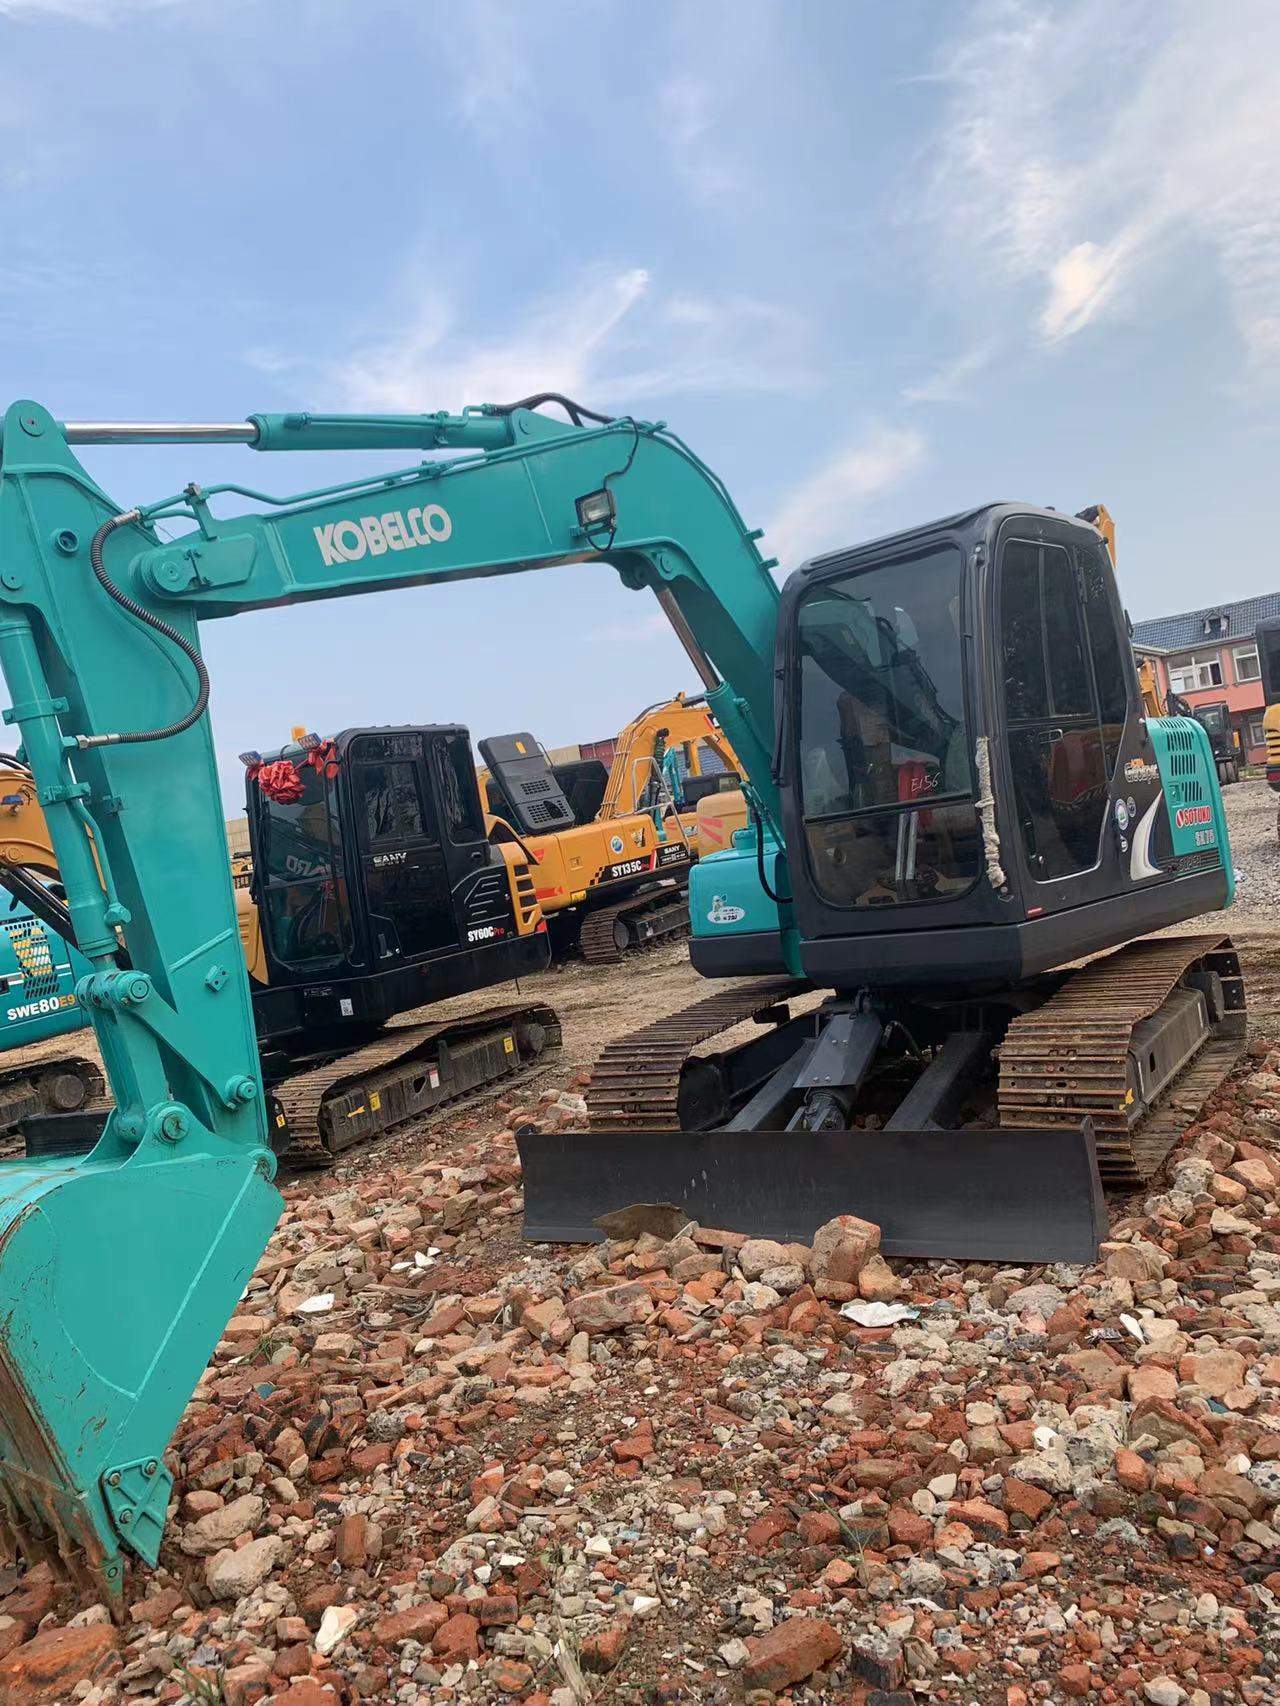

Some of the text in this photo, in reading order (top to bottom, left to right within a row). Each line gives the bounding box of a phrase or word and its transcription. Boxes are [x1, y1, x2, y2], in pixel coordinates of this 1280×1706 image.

[313, 504, 452, 566] KOBELCO
[911, 771, 940, 792] E156
[664, 845, 680, 854] SANY
[7, 994, 76, 1020] SWE80E9
